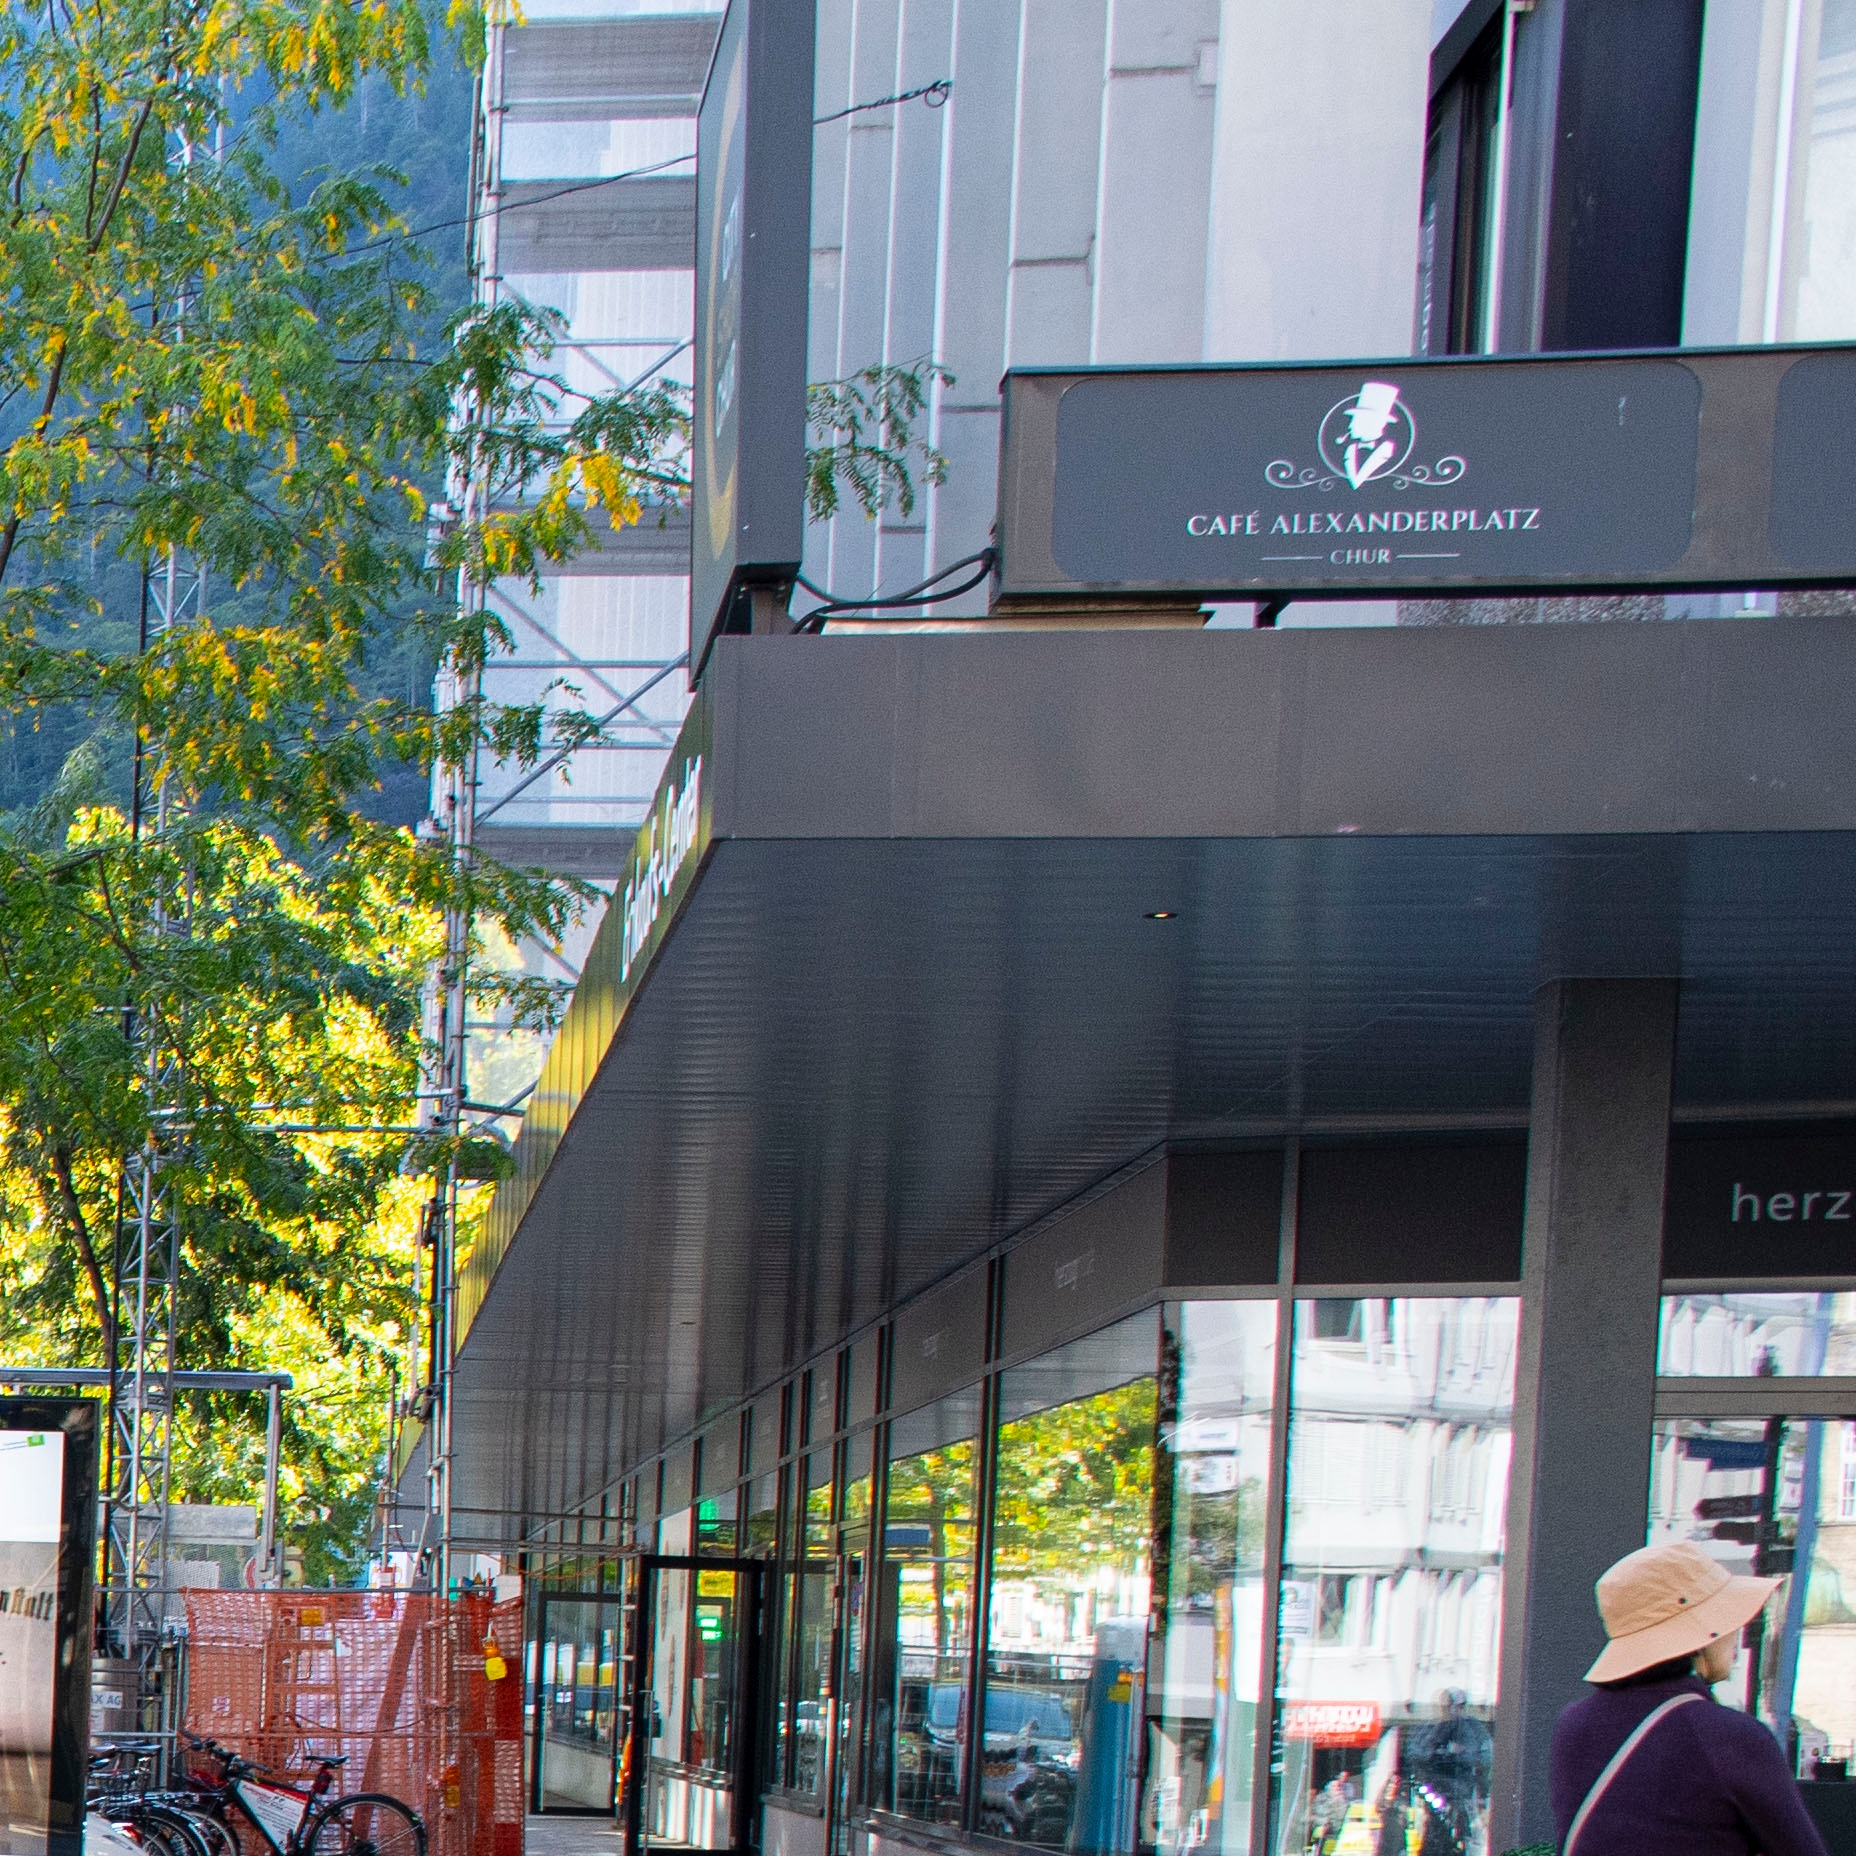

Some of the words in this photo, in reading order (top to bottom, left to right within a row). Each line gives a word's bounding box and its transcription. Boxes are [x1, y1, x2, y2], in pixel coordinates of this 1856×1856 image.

[1186, 508, 1260, 536] CAFÉ
[1269, 507, 1540, 535] ALEXANDERPLATZ
[1329, 548, 1392, 566] CHUR
[1731, 1182, 1852, 1222] herz
